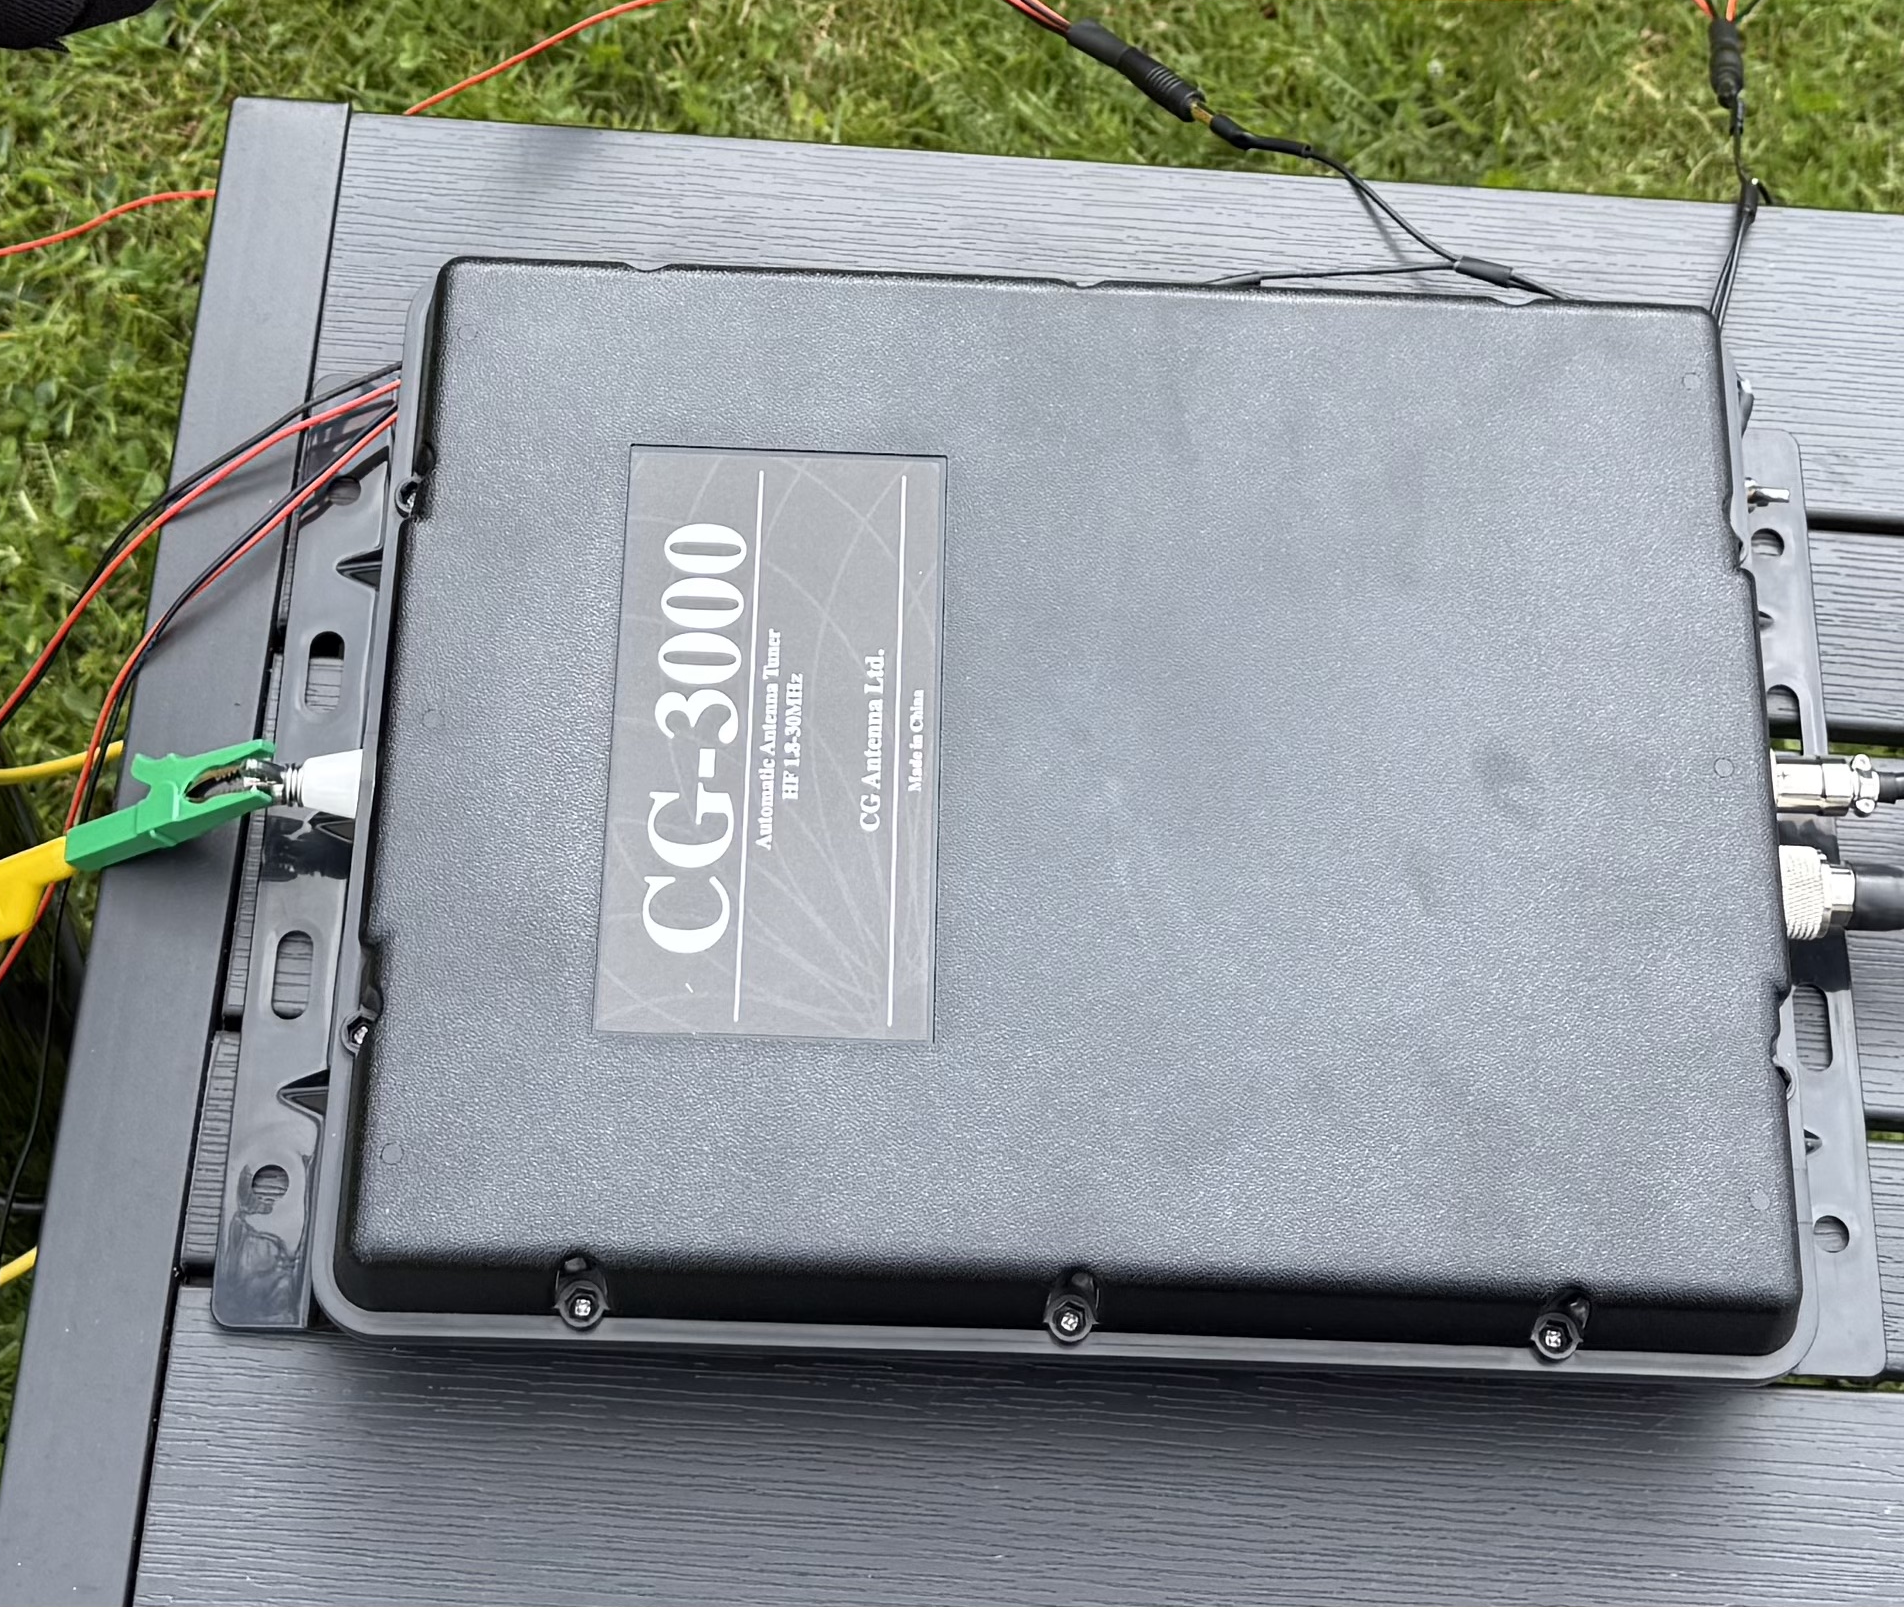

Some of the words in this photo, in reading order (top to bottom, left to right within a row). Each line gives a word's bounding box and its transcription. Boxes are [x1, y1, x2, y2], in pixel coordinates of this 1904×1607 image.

[761, 627, 781, 679] Tuner
[863, 648, 885, 693] Ltd.
[759, 683, 779, 755] Antenna
[783, 673, 804, 766] 1.8-30MHz
[909, 689, 925, 732] China
[642, 523, 747, 954] CG-3000
[860, 698, 884, 789] Antenna
[908, 735, 924, 749] in
[781, 771, 799, 800] HF
[907, 750, 923, 791] Made
[754, 758, 776, 850] Automatic
[859, 794, 881, 831] CG
